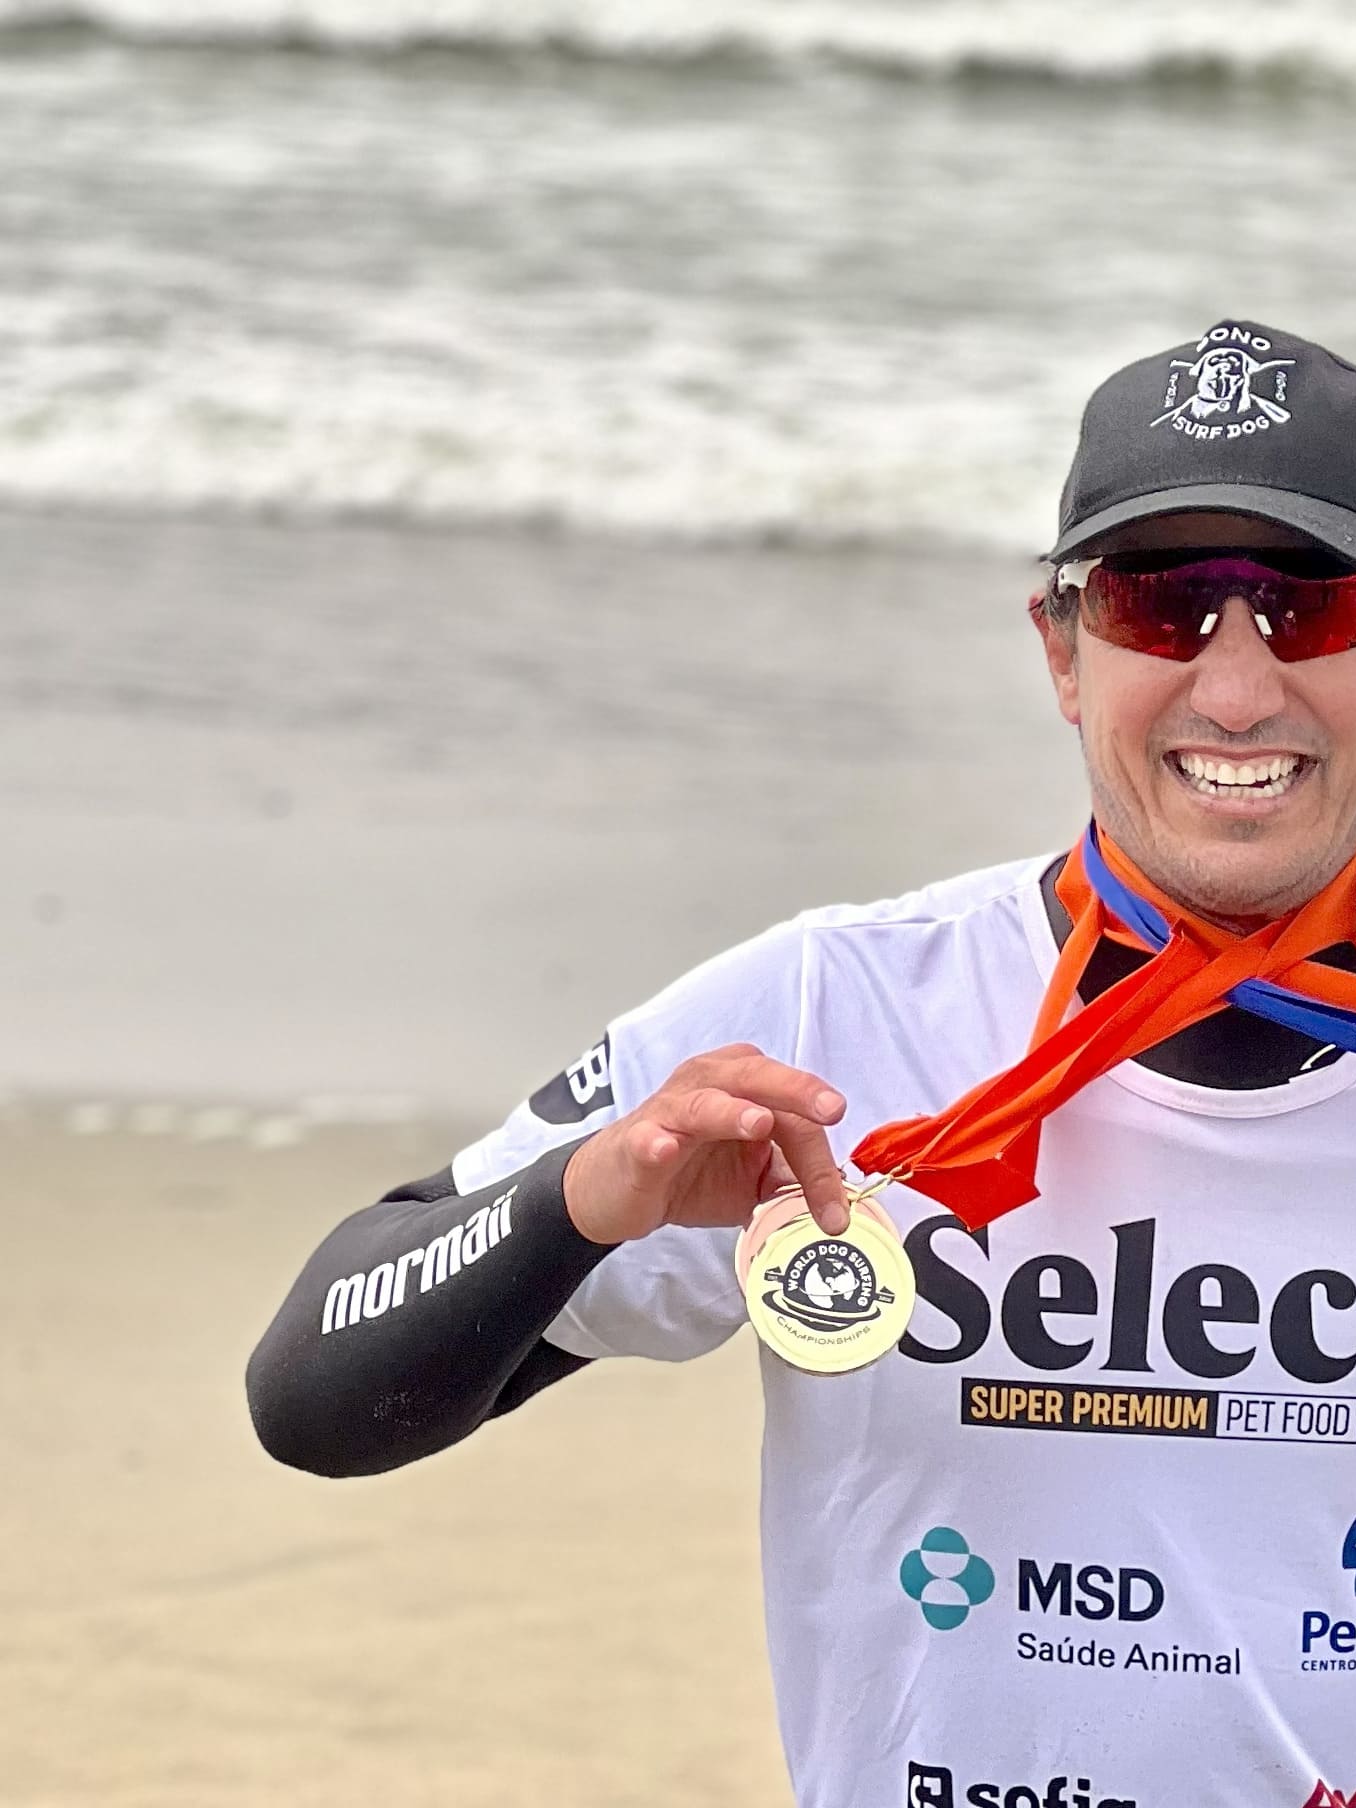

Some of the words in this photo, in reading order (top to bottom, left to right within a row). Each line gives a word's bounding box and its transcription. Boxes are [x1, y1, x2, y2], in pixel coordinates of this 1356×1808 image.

[1172, 415, 1223, 440] SURF
[1226, 415, 1270, 439] DOG
[320, 1184, 519, 1336] mormaii
[787, 1249, 817, 1292] WORLD
[818, 1244, 848, 1256] DOG
[848, 1251, 873, 1307] SURFING
[776, 1316, 871, 1345] CHAMPIONSHIPS
[969, 1385, 1063, 1424] SUPER
[1072, 1391, 1209, 1431] PREMIUM
[1225, 1398, 1275, 1434] PET
[1281, 1402, 1351, 1437] FOOD
[1018, 1558, 1165, 1622] MSD
[1017, 1632, 1116, 1669] Saúde
[1123, 1643, 1241, 1675] Animal
